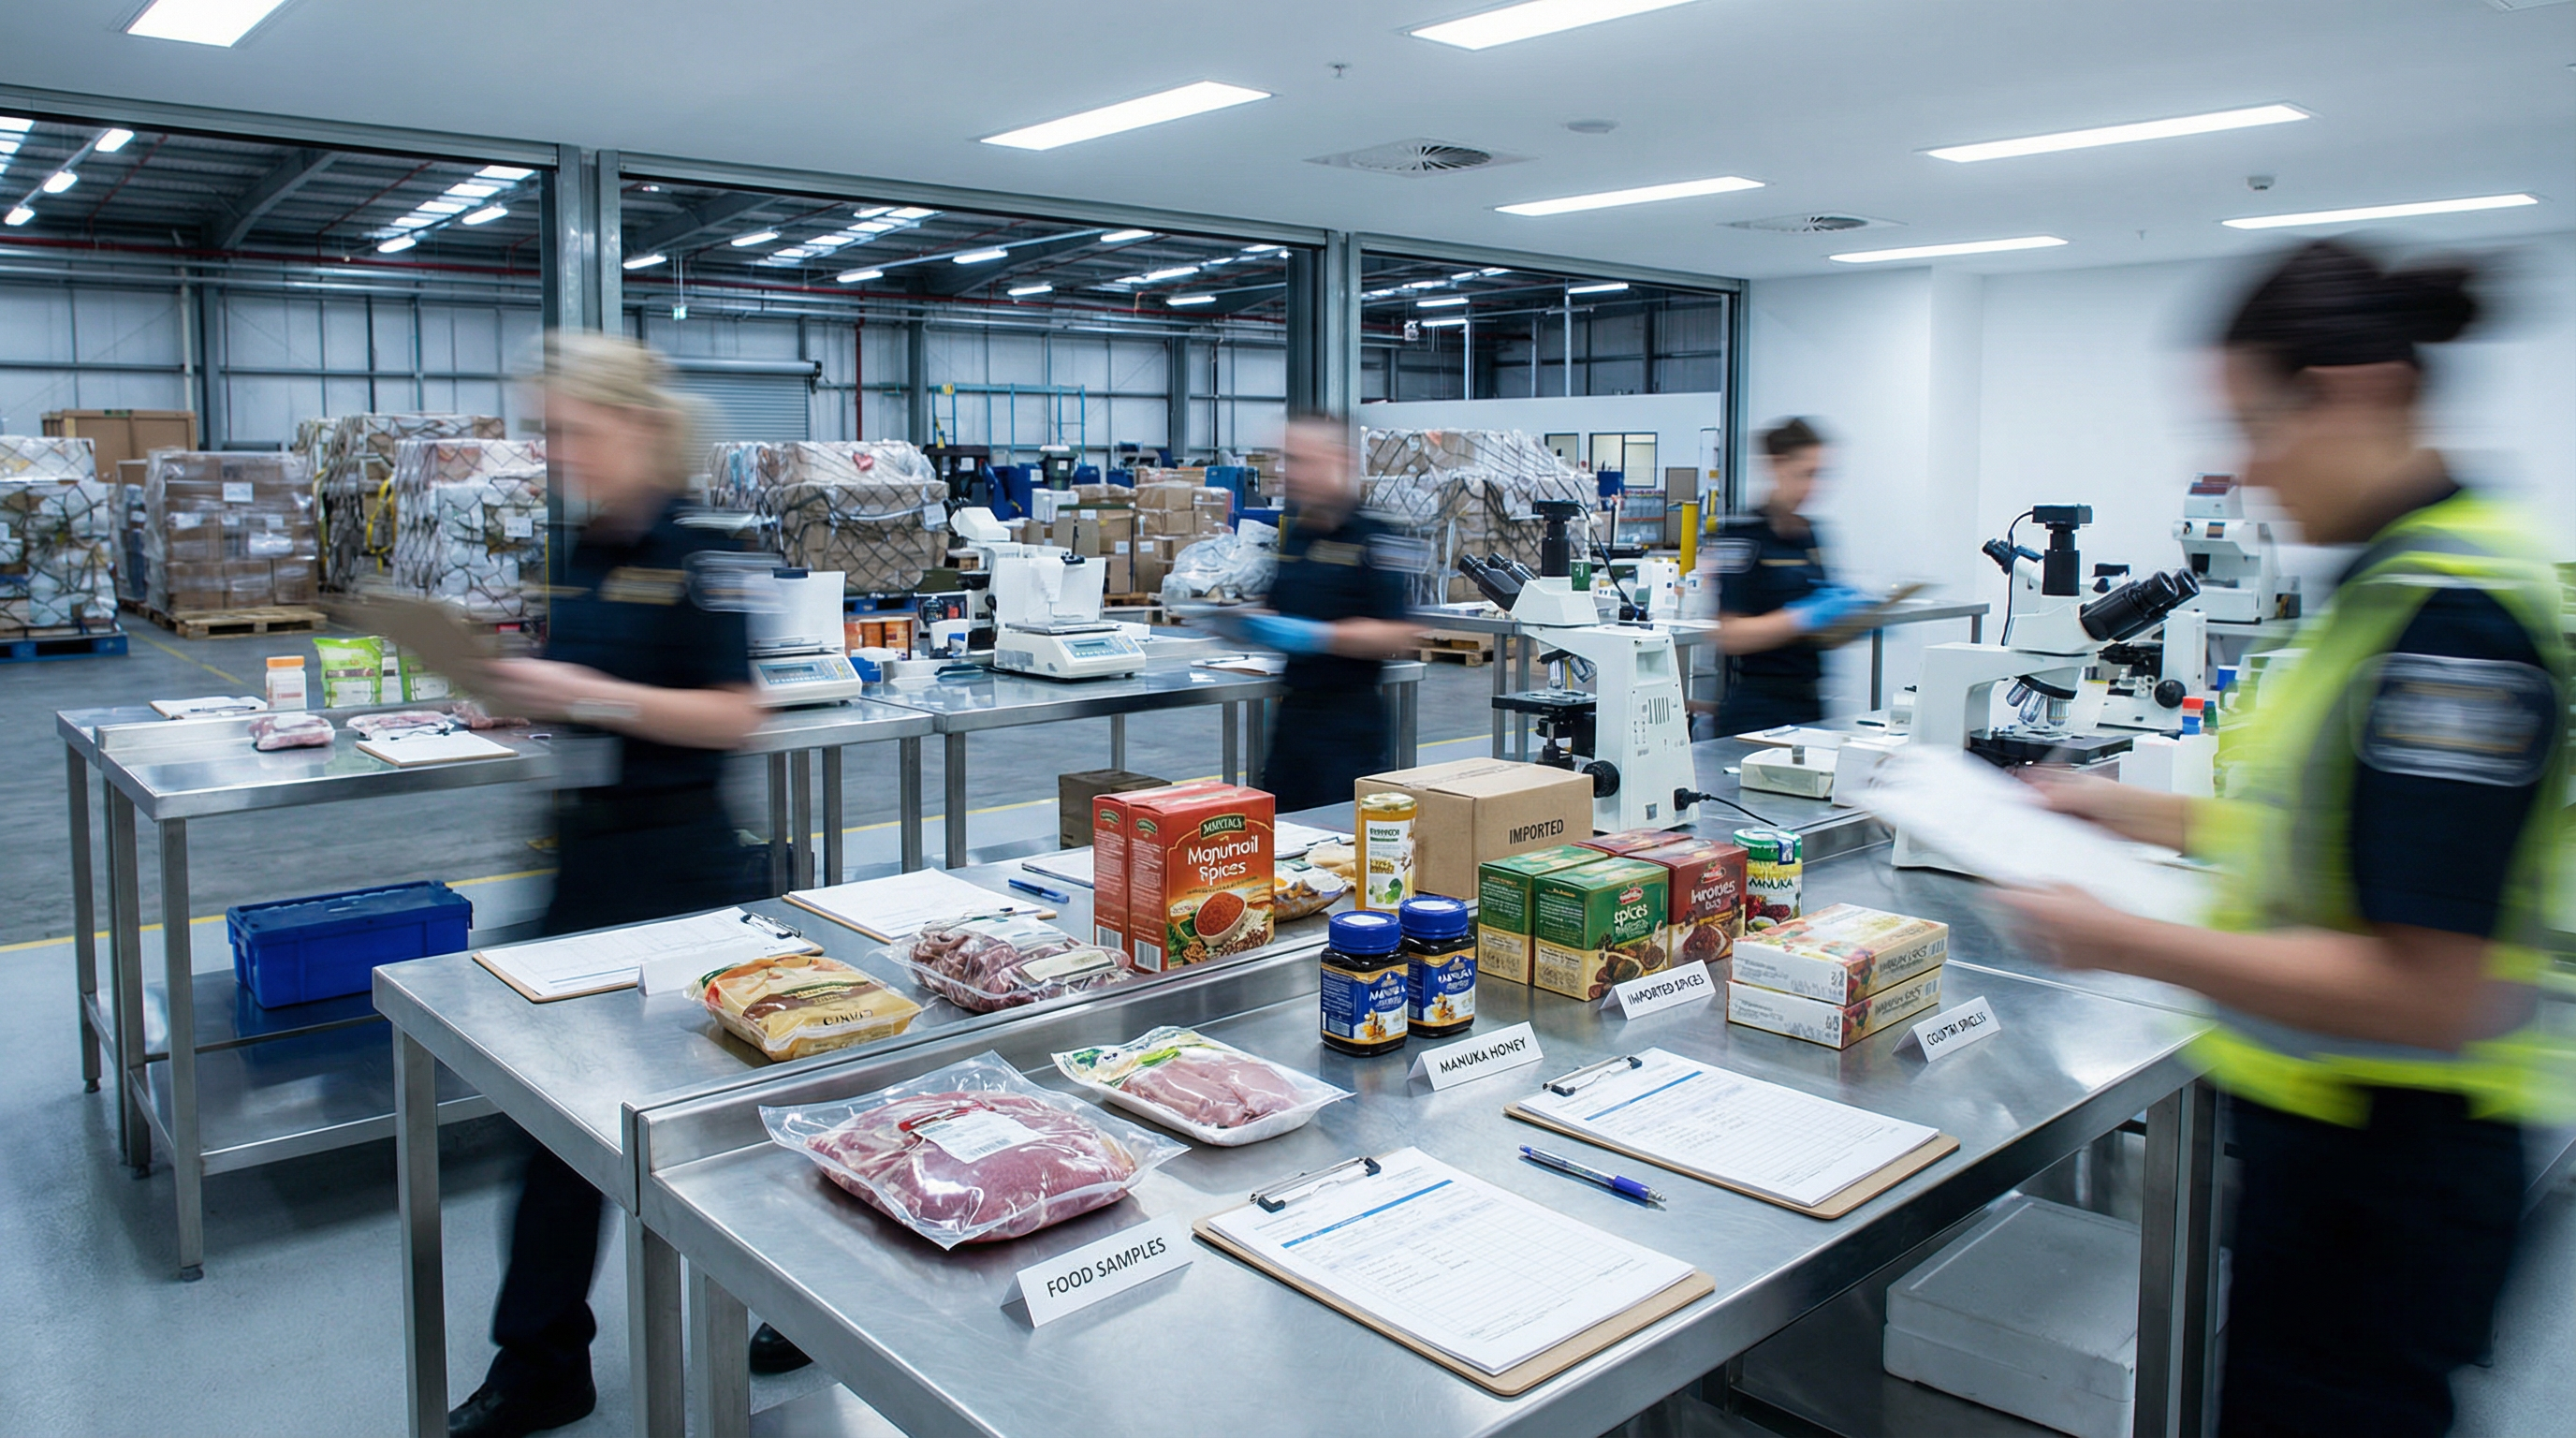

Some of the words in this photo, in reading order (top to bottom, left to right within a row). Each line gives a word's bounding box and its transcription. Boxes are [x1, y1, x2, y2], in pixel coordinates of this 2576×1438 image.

[1509, 818, 1564, 845] IMPORTED
[1439, 1049, 1489, 1074] MANUKA
[1488, 1036, 1527, 1060] HONEY
[1046, 1267, 1093, 1298] FOOD
[1096, 1237, 1166, 1278] SAMPLES
